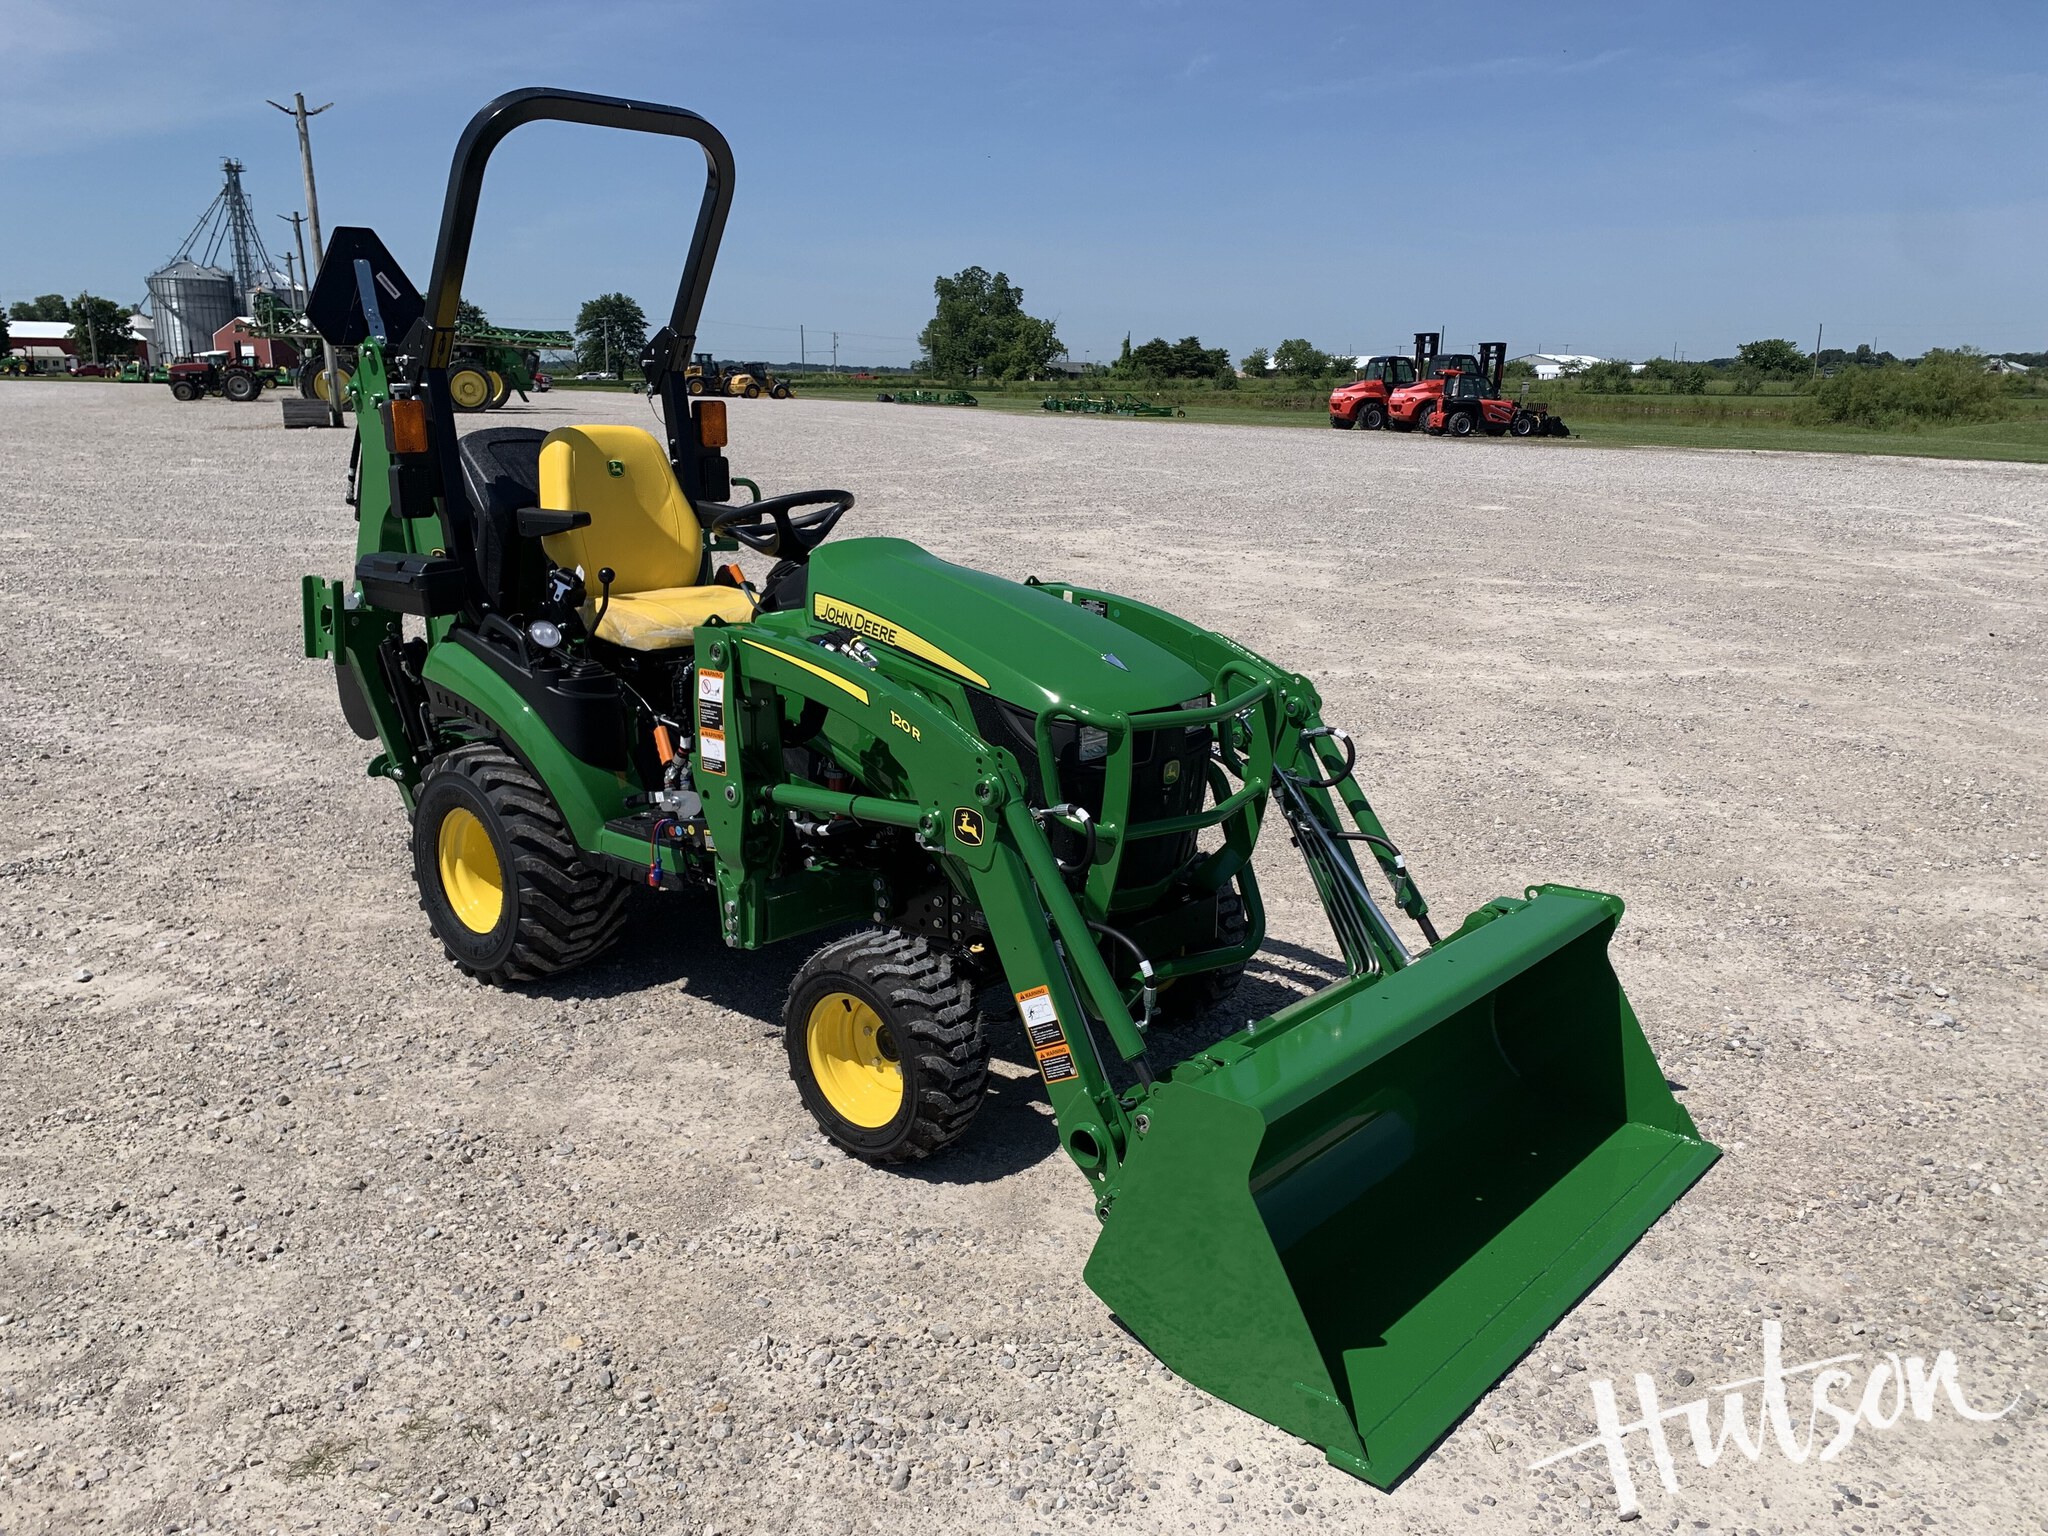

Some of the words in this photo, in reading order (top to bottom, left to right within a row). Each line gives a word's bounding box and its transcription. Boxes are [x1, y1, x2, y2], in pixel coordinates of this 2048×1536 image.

[820, 603, 853, 629] JOHN
[854, 613, 898, 644] DEERE
[890, 709, 911, 733] 120
[911, 725, 921, 742] R
[1024, 988, 1045, 998] WARNING
[1046, 1048, 1067, 1057] WARNING
